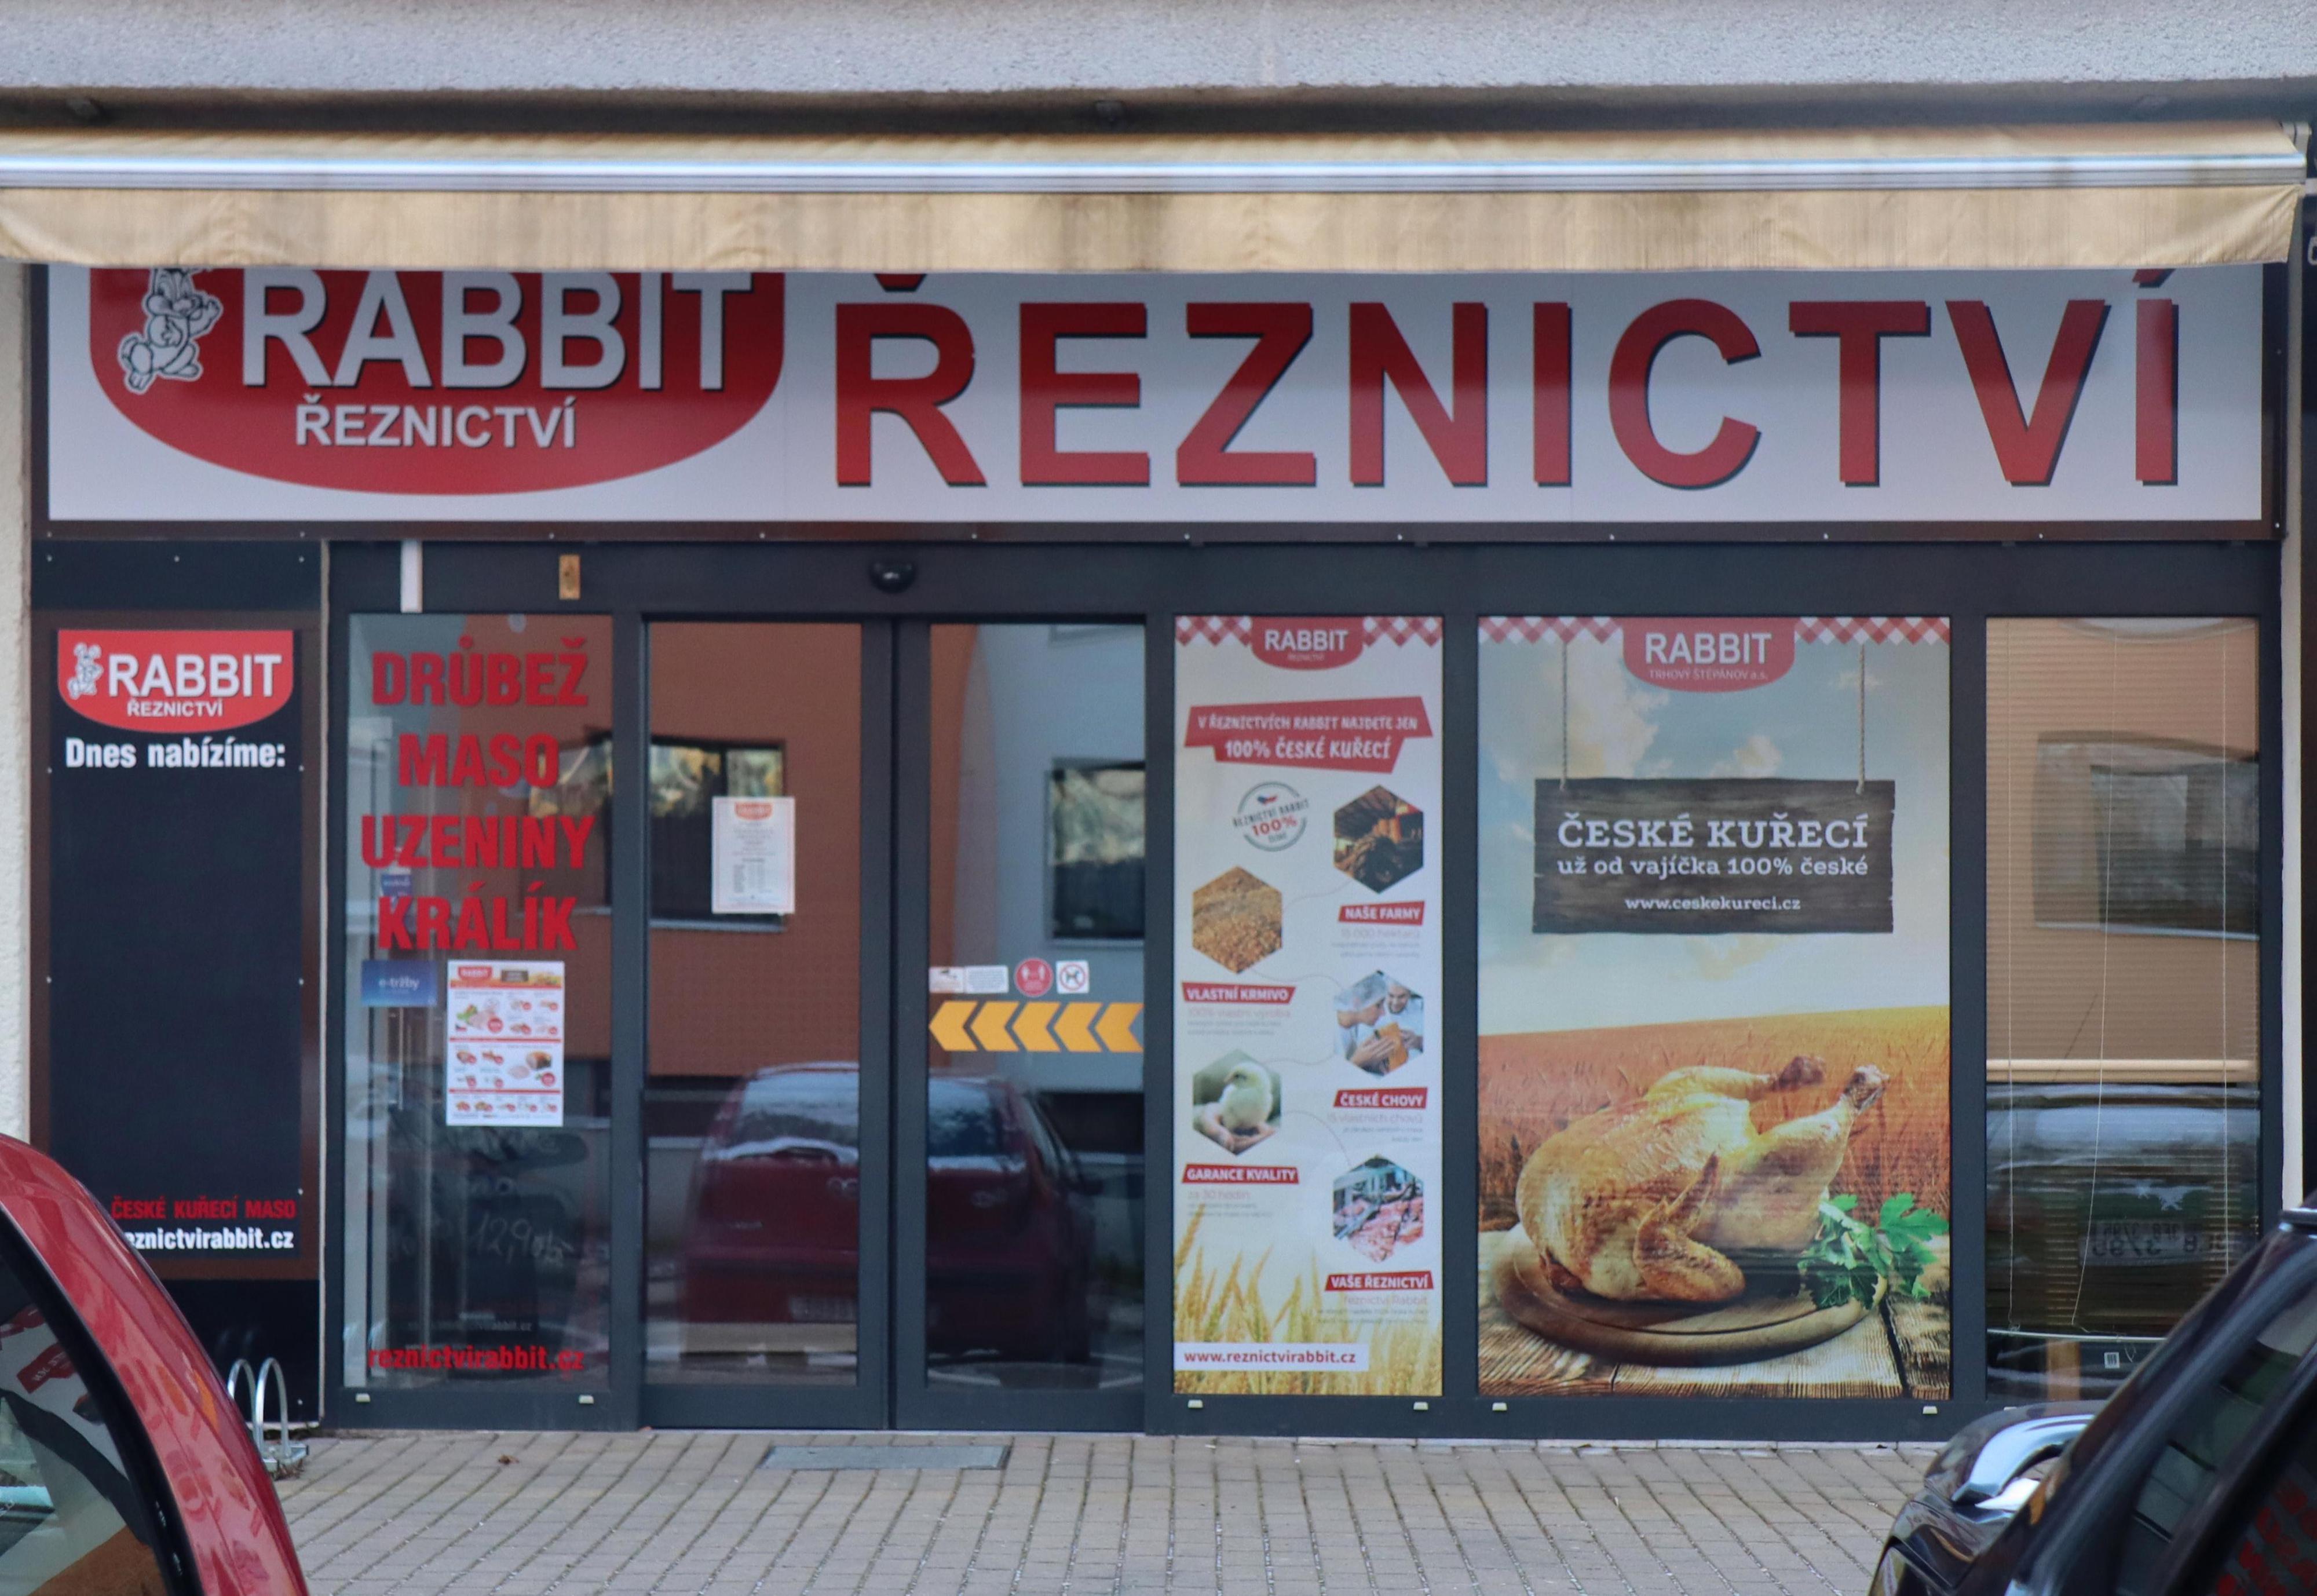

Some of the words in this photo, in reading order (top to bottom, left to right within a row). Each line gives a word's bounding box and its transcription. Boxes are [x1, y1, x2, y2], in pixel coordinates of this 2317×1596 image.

[242, 271, 755, 391] RABBIT
[835, 269, 2177, 490] ŘEZNICTVÍ
[296, 396, 577, 447] ŘEZNICTVÍ
[1265, 629, 1348, 651] RABBIT
[1645, 633, 1772, 664] RABBIT
[108, 653, 282, 697] RABBIT
[372, 636, 587, 706] DRŮBEŽ
[127, 697, 223, 717] ŘEZNICTVÍ
[1293, 716, 1337, 730] RABBIT
[1341, 717, 1393, 729] NAJDETE
[1396, 717, 1417, 729] JEN
[65, 737, 136, 768] Dnes
[148, 736, 285, 768] nabízíme:
[1225, 739, 1270, 758] 100%
[1276, 736, 1325, 758] ČESKÉ
[1330, 736, 1391, 759] KUŘECÍ
[399, 733, 558, 787] MASO
[1252, 815, 1298, 836] 100%
[1558, 812, 1694, 848] ČESKÉ
[1707, 812, 1869, 848] KUŘECÍ
[361, 816, 595, 868] UZENINY
[1557, 856, 1587, 875] už
[1594, 856, 1624, 875] od
[1630, 854, 1720, 881] vajíčka
[1727, 857, 1793, 876] 100%
[1800, 854, 1869, 876] české
[1345, 907, 1377, 920] NAŠE
[1379, 908, 1420, 920] FARMY
[1625, 895, 1801, 911] www.ceskekureci.cz
[378, 881, 578, 950] KRÁLÍK
[1186, 985, 1238, 1000] VLASTNÍ
[1240, 988, 1289, 1001] KRMIVO
[1340, 1091, 1379, 1106] ČESKÉ
[1382, 1094, 1423, 1107] CHOVY
[1187, 1168, 1244, 1181] GARANCE
[1247, 1168, 1296, 1181] KVALITY
[111, 1195, 166, 1219] ČESKÉ
[174, 1195, 239, 1219] KUŘECÍ
[245, 1199, 297, 1219] MASO
[123, 1226, 294, 1250] eznictvirabbit.cz
[1331, 1274, 1361, 1288] VAŠE
[1365, 1274, 1428, 1288] ŘEZNICTVÍ
[368, 1344, 584, 1369] reznictvirabbit.cz
[1184, 1349, 1356, 1363] www.reznictvirabbit.cz
